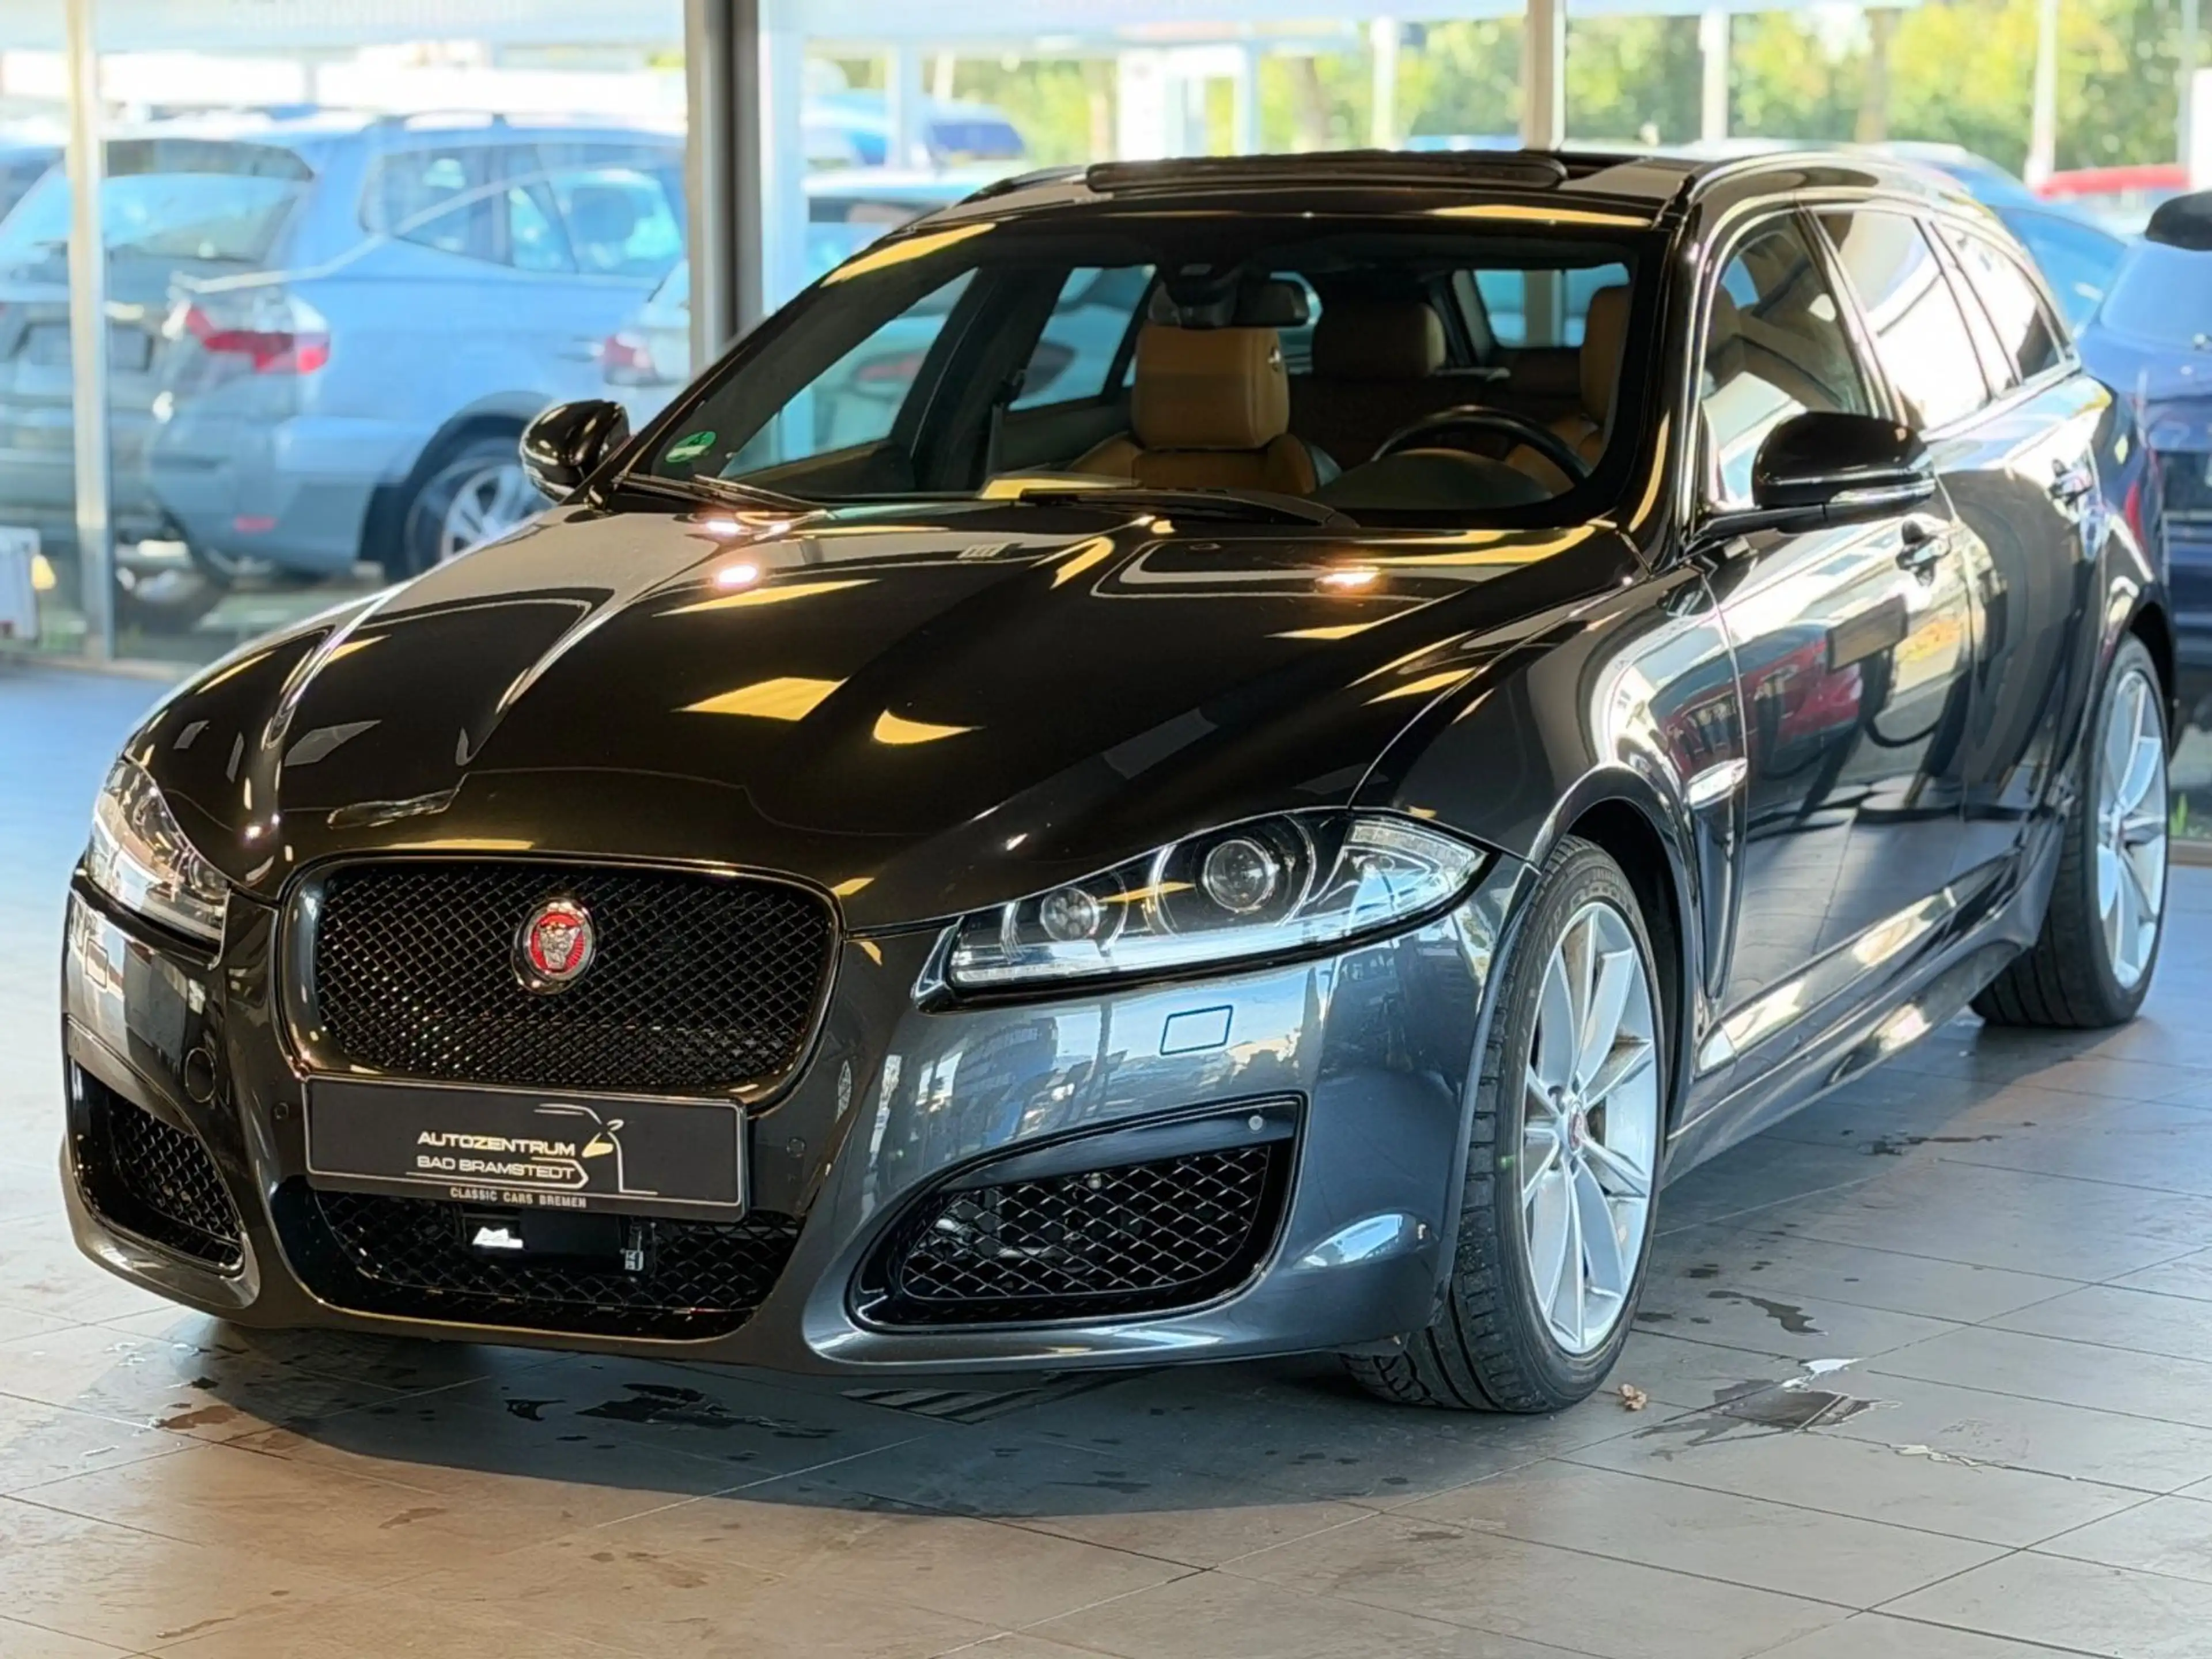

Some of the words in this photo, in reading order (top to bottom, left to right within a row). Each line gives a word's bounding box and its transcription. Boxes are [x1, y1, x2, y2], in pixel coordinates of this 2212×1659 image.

[417, 1131, 575, 1156] AUTOZENTRUM
[417, 1156, 456, 1170] BAD
[459, 1158, 575, 1180] BRAMSTEDT
[450, 1187, 498, 1202] CLASSIC
[503, 1191, 533, 1205] CARS
[539, 1195, 587, 1209] BREMEN
